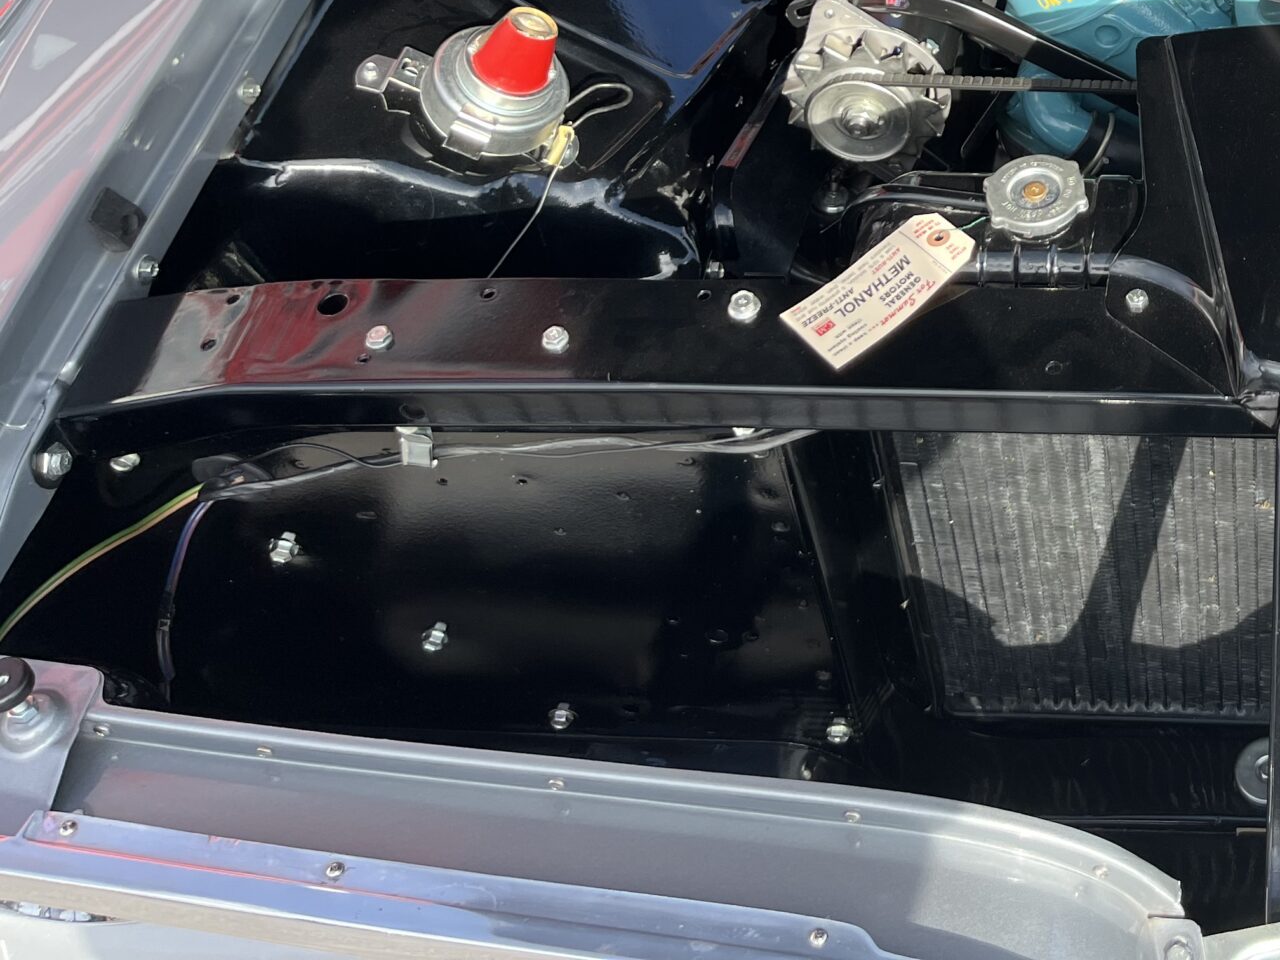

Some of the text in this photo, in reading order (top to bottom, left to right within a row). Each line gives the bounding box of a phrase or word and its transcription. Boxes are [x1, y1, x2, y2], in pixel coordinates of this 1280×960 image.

[834, 254, 910, 317] METHANOL
[878, 270, 914, 301] MOTORS
[884, 275, 921, 308] GENERAL
[800, 287, 853, 327] ANTI-FREEZE
